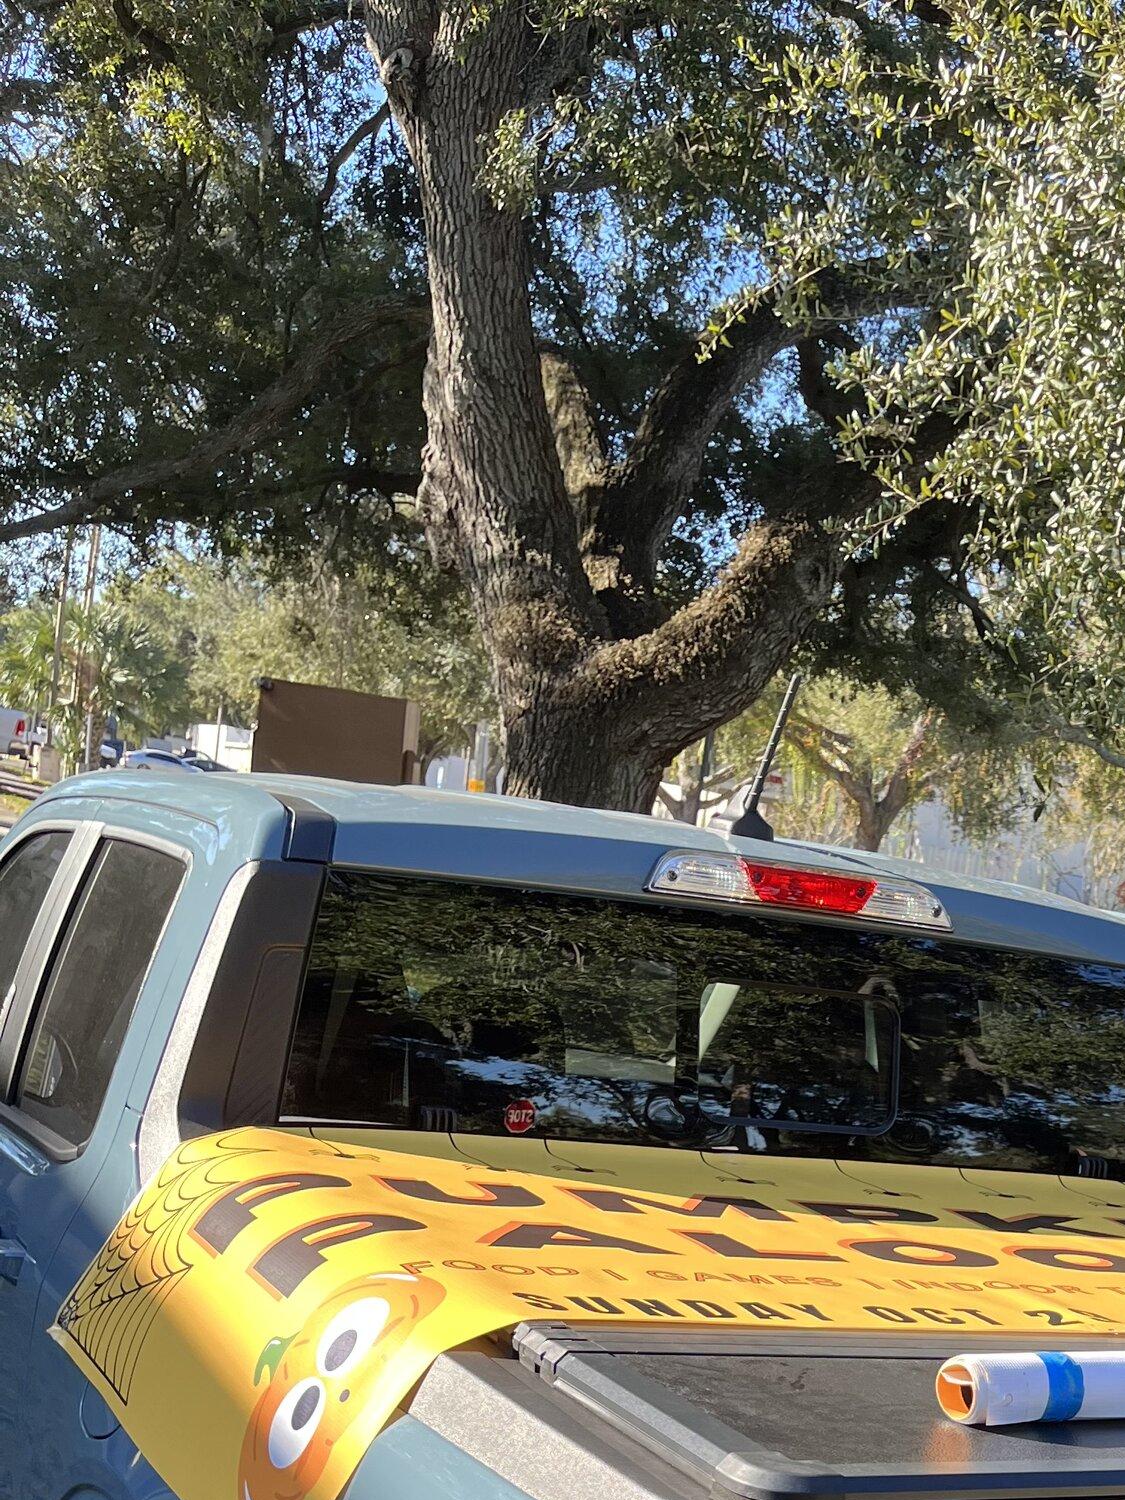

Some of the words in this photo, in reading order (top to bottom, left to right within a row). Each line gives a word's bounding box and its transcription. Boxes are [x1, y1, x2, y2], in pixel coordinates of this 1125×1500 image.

[399, 1259, 580, 1277] FOOD
[646, 1269, 843, 1289] GAMES
[893, 1278, 1094, 1295] INDOOR
[511, 1292, 835, 1322] SUNDAY
[862, 1305, 1004, 1326] OCT
